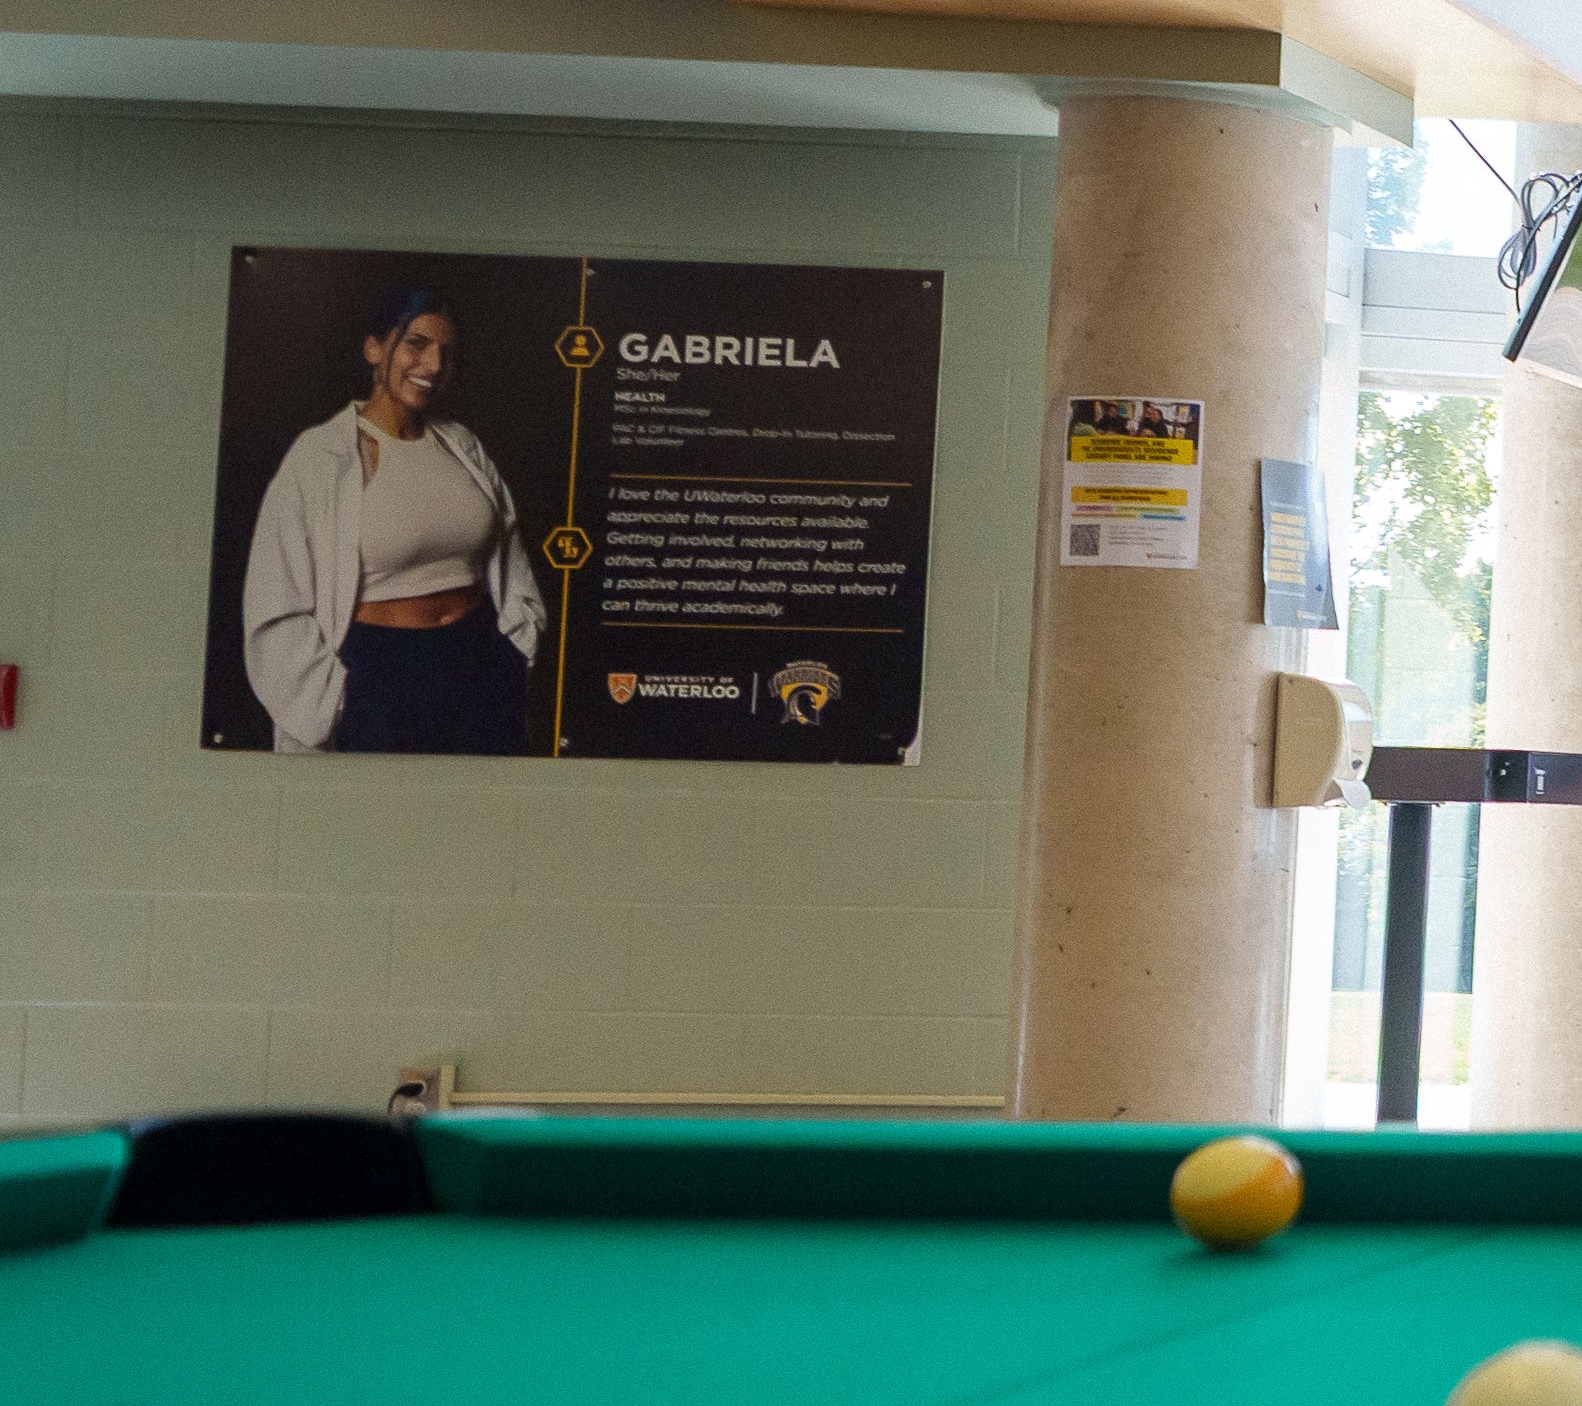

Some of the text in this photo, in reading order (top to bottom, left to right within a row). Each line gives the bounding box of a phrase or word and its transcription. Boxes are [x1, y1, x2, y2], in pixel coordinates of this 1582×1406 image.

[619, 333, 841, 368] GABRIELA
[615, 367, 681, 382] She/Her
[614, 391, 666, 402] HEALTH
[608, 487, 890, 508] I love the UWaterloo community and
[606, 511, 870, 529] appreciate the resources available.
[606, 532, 665, 548] Getting
[740, 536, 828, 552] networking
[831, 538, 865, 551] with
[661, 557, 693, 569] and
[695, 557, 753, 572] making
[756, 557, 810, 572] friends
[812, 559, 855, 574] helps
[857, 562, 907, 575] create
[602, 578, 897, 596] a positive mental health space where I
[601, 599, 631, 612] can
[634, 599, 680, 613] thrive
[645, 675, 715, 684] UNIVERSITY
[639, 684, 740, 699] WATERLOO
